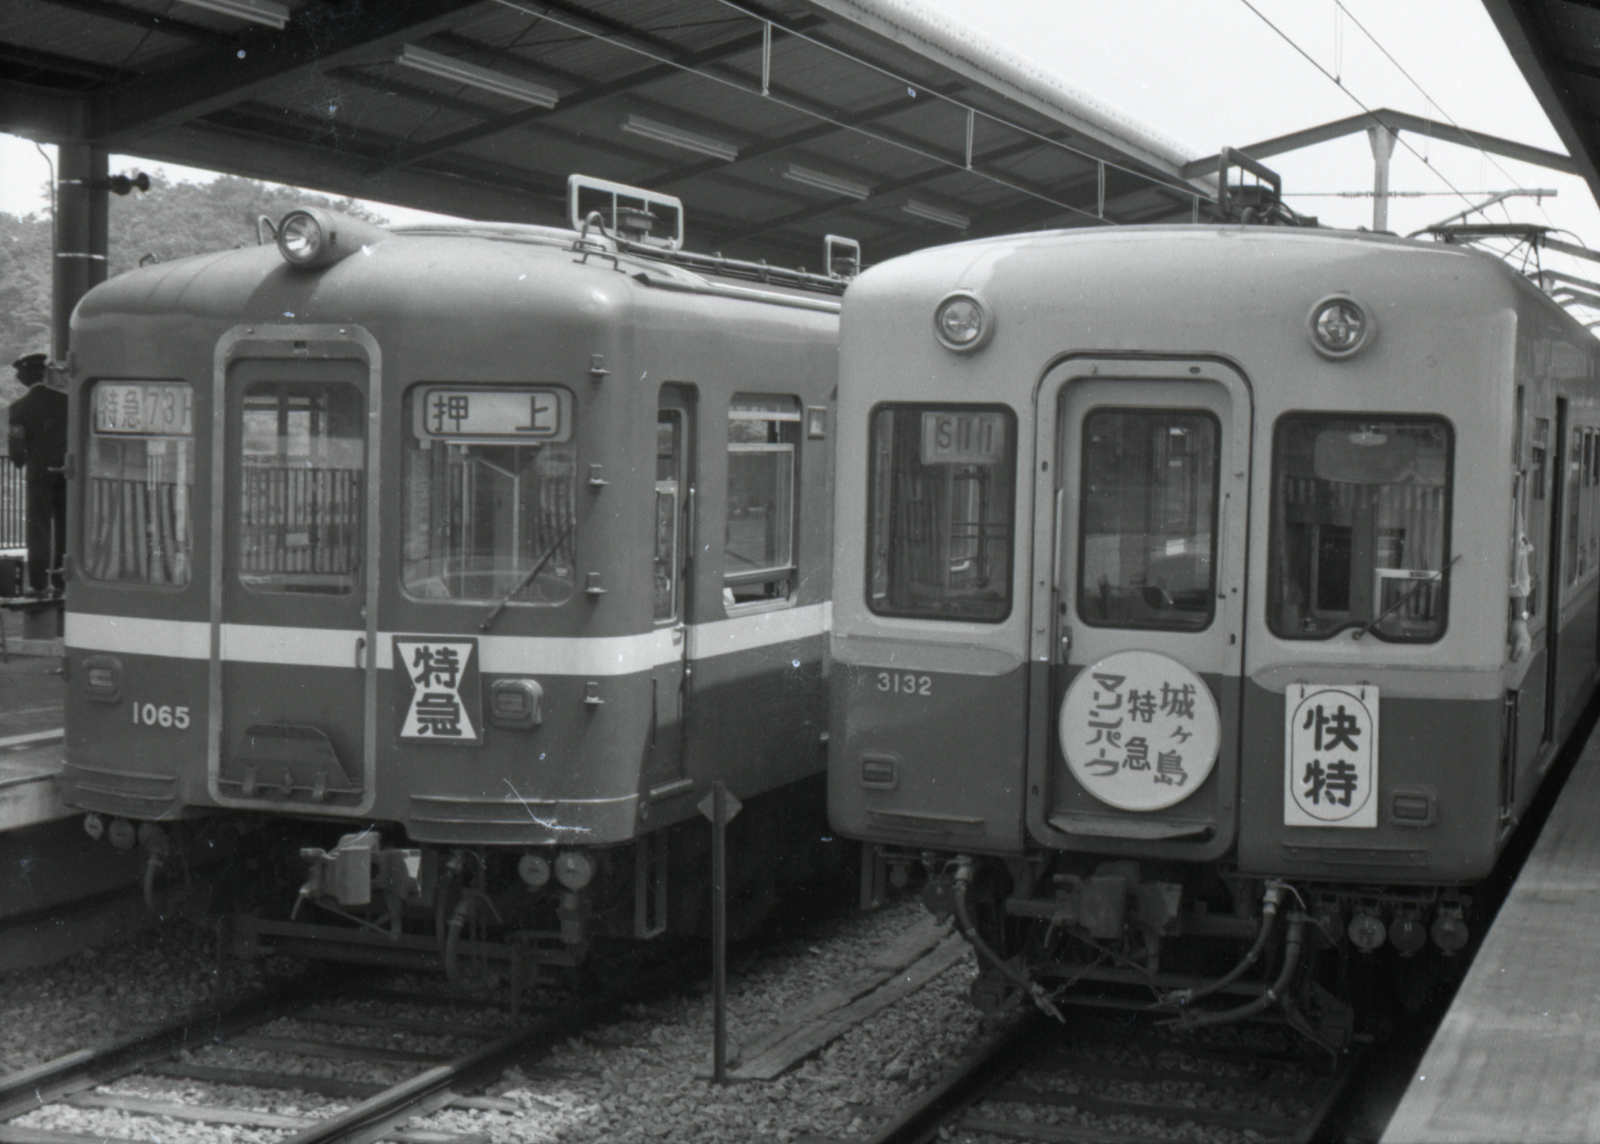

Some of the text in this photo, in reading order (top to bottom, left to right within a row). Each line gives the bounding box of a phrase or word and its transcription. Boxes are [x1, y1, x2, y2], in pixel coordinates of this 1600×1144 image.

[98, 388, 141, 429] 特急
[132, 701, 191, 730] 1065
[412, 644, 463, 737] 特急
[876, 671, 932, 696] 3132
[1083, 672, 1128, 777] マリンパーク
[1121, 688, 1158, 772] 特急
[1301, 703, 1363, 809] 快特
